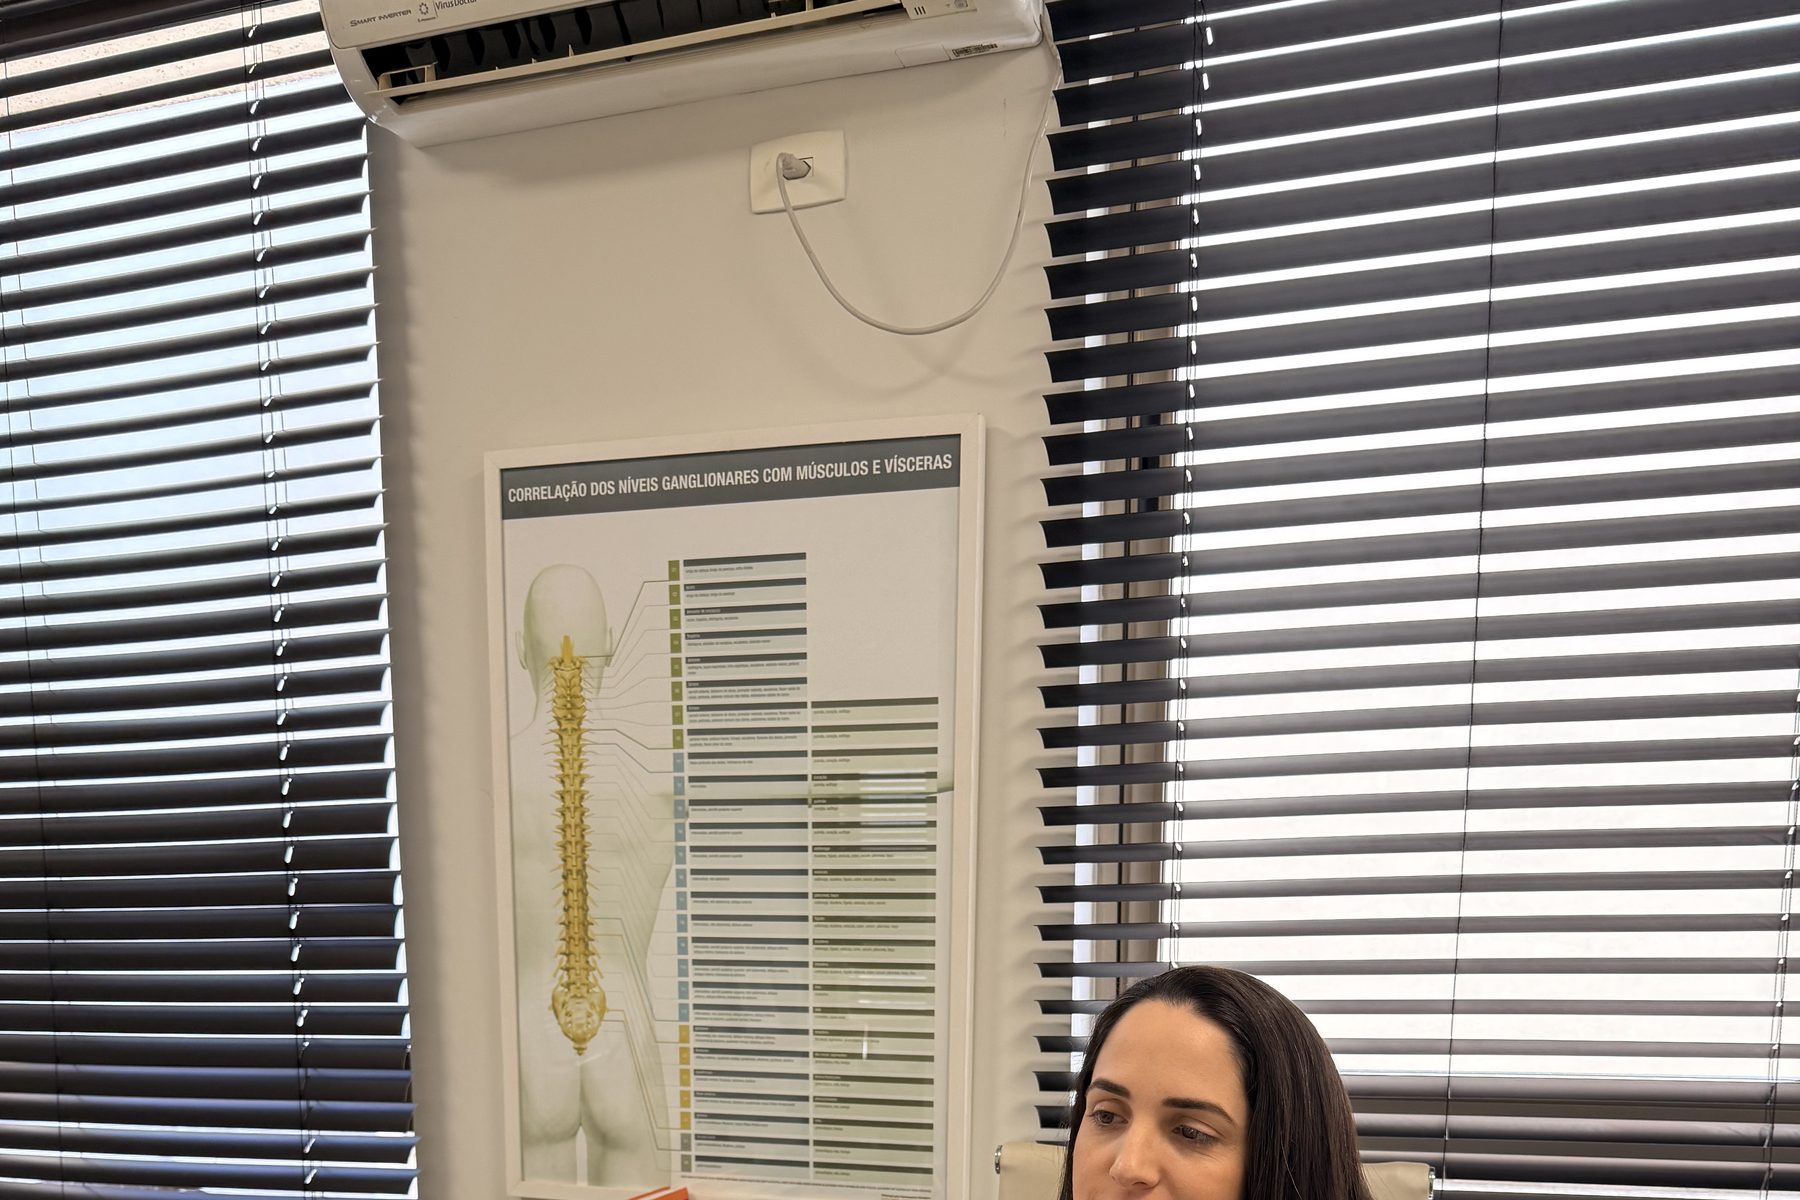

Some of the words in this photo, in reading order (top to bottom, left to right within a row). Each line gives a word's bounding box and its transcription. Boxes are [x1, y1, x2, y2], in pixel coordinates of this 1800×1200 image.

[508, 481, 587, 502] CORRELAÇÃO
[590, 481, 615, 496] DOS
[619, 476, 658, 494] NÍVEIS
[662, 469, 759, 491] GANGLIONARES
[763, 467, 792, 483] COM
[796, 460, 868, 481] MÚSCULOS
[873, 460, 881, 474] E
[884, 453, 952, 473] VÍSCERAS
